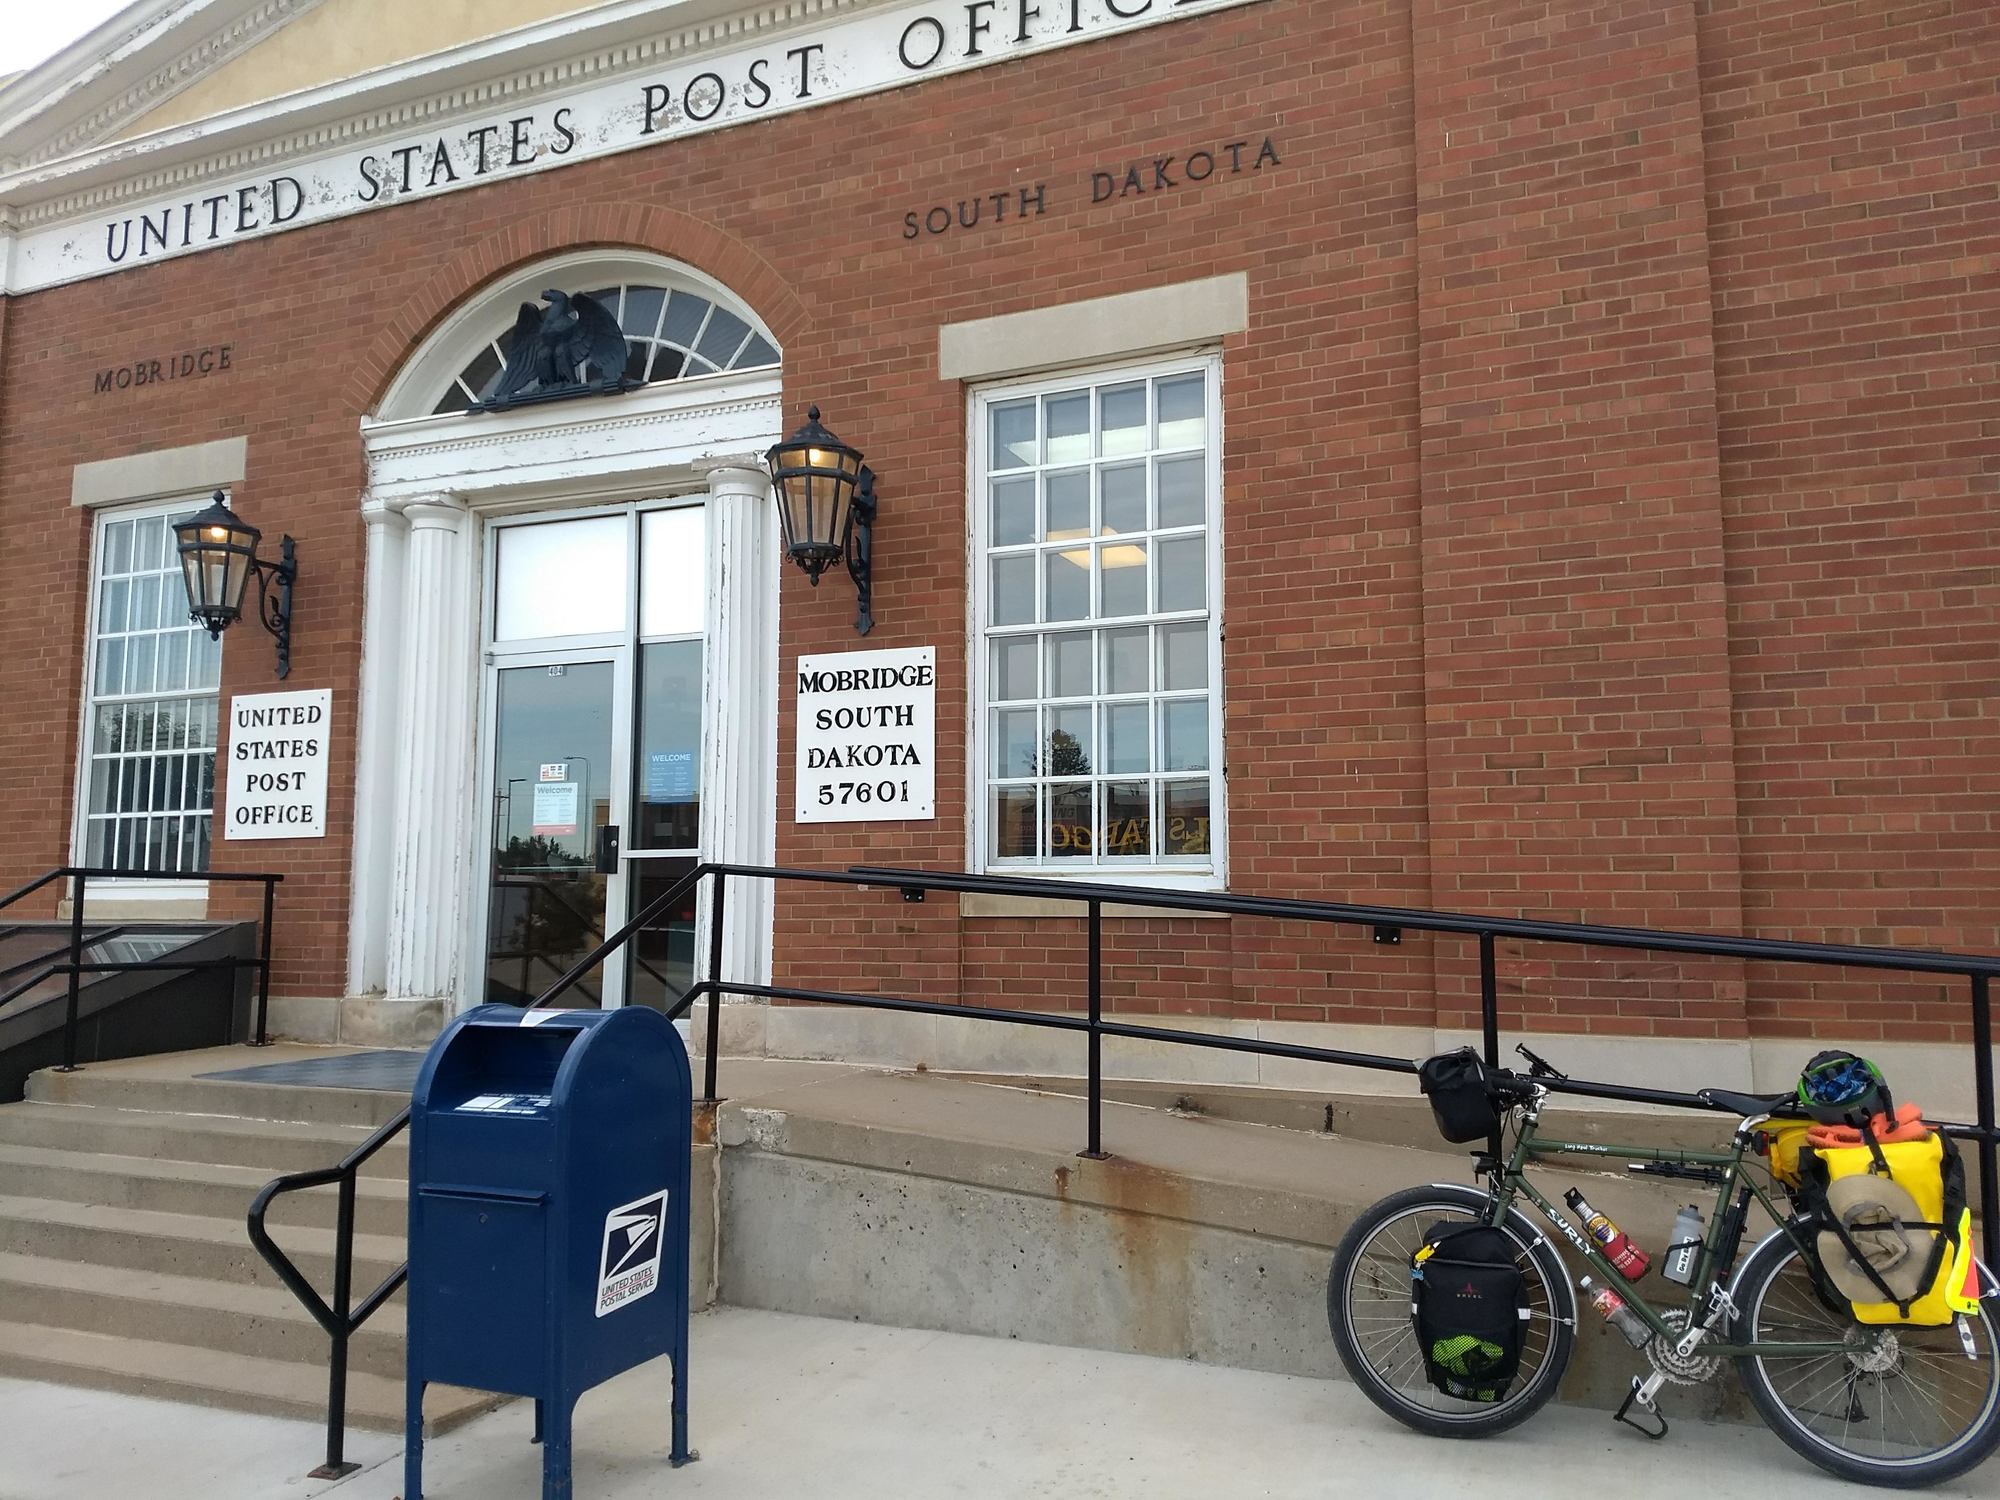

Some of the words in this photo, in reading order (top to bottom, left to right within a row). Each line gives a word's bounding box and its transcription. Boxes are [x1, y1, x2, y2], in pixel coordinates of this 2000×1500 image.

[106, 176, 303, 263] UNITED
[357, 107, 575, 202] STATES
[640, 43, 824, 135] POST
[899, 0, 1196, 69] OFFI
[903, 184, 1047, 240] SOUTH
[1091, 136, 1283, 204] DAKOTA
[93, 343, 234, 394] MOBRIDGE
[799, 665, 934, 694] MOBRIDGE
[238, 706, 321, 727] UNITED
[815, 704, 914, 730] SOUTH
[236, 739, 318, 760] STATES
[651, 753, 691, 762] WELCOME
[807, 743, 921, 769] DAKOTA
[246, 771, 306, 792] POST
[537, 785, 572, 794] Welcome
[818, 780, 909, 806] 57601
[236, 804, 313, 825] OFFICE
[1547, 1208, 1596, 1255] SURLY
[600, 1291, 626, 1309] POSTAL
[627, 1275, 655, 1297] SERVICE
[602, 1278, 629, 1296] UNITED
[629, 1266, 653, 1284] STATES
